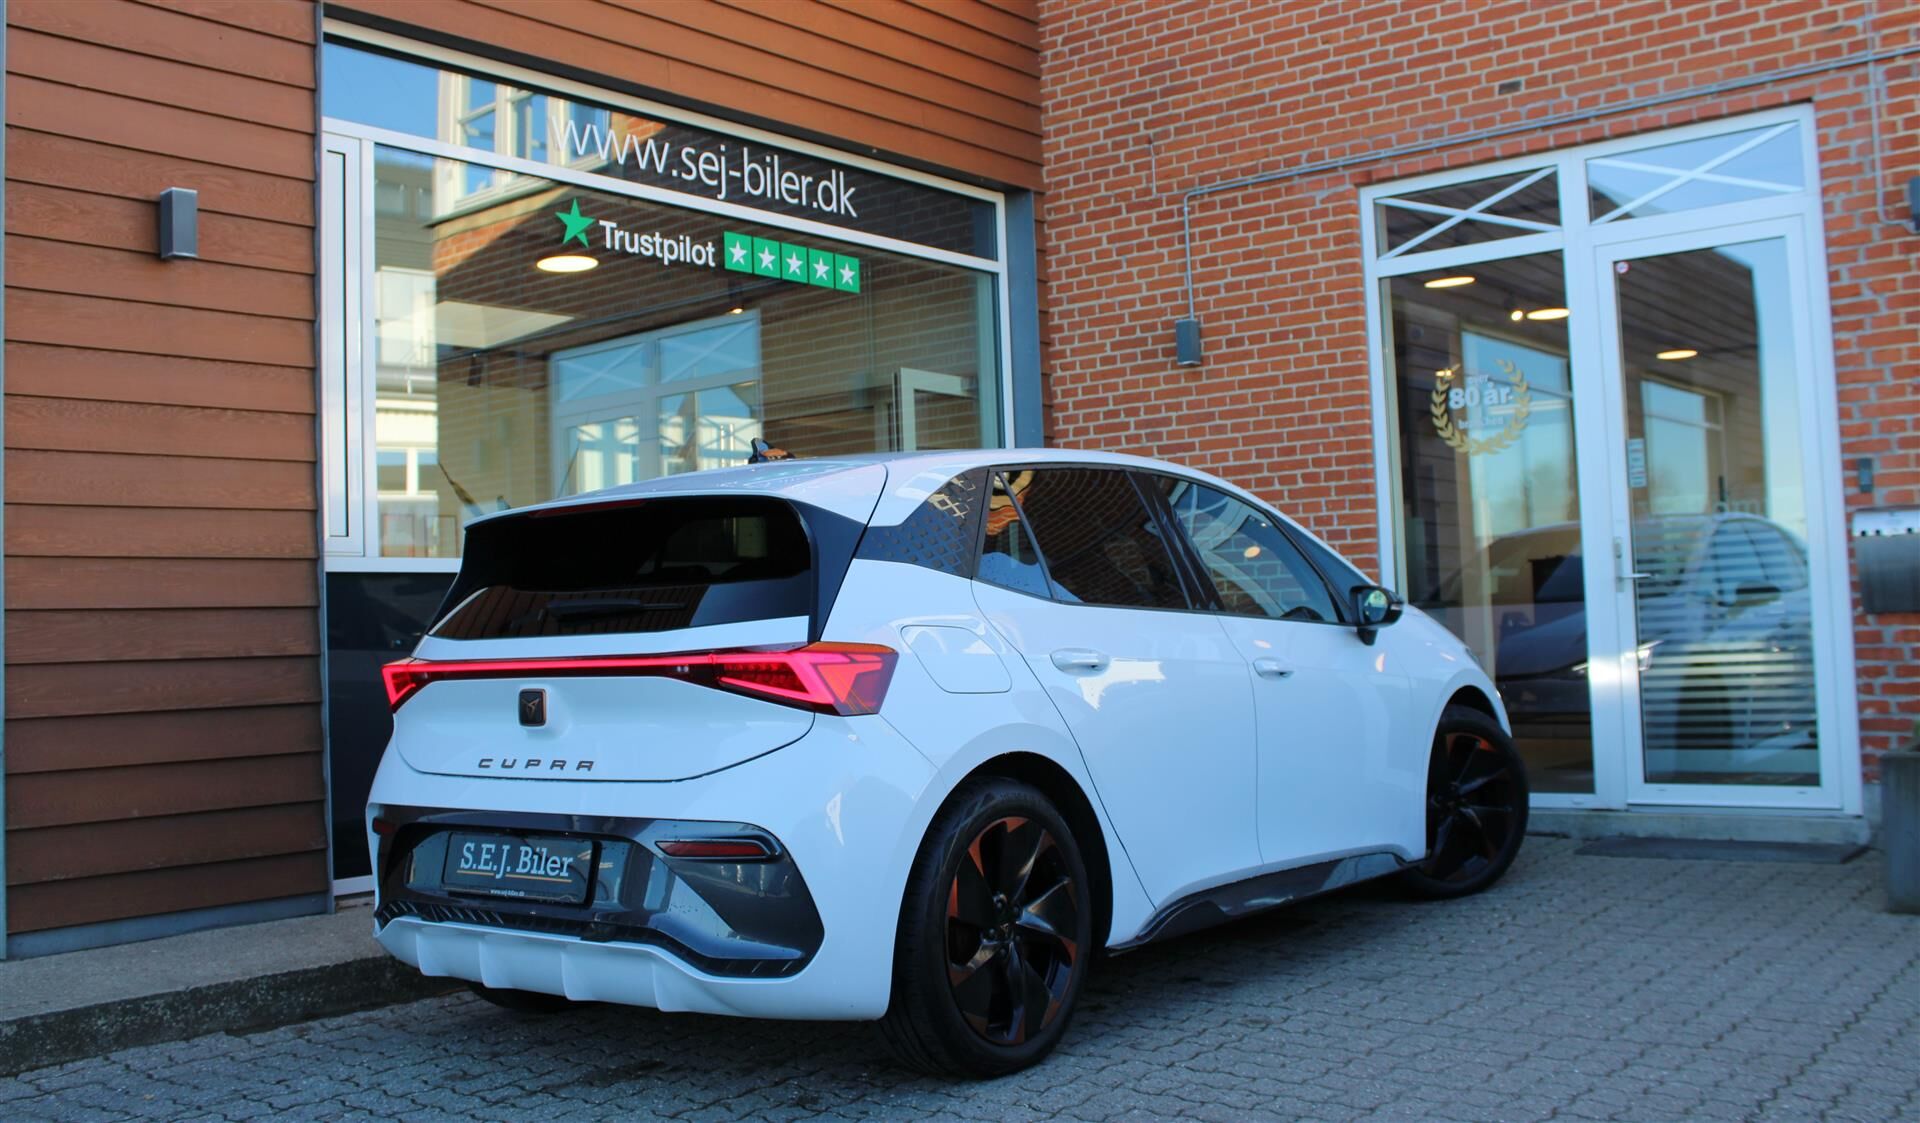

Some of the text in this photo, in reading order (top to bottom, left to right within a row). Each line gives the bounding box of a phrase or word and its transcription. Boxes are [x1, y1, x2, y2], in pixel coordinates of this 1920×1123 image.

[552, 115, 858, 218] www.sej-biler.dk
[598, 219, 716, 268] Trustpilot
[1448, 386, 1480, 409] 80
[478, 757, 595, 772] CUPRA
[460, 842, 574, 880] S.E.J. Biler
